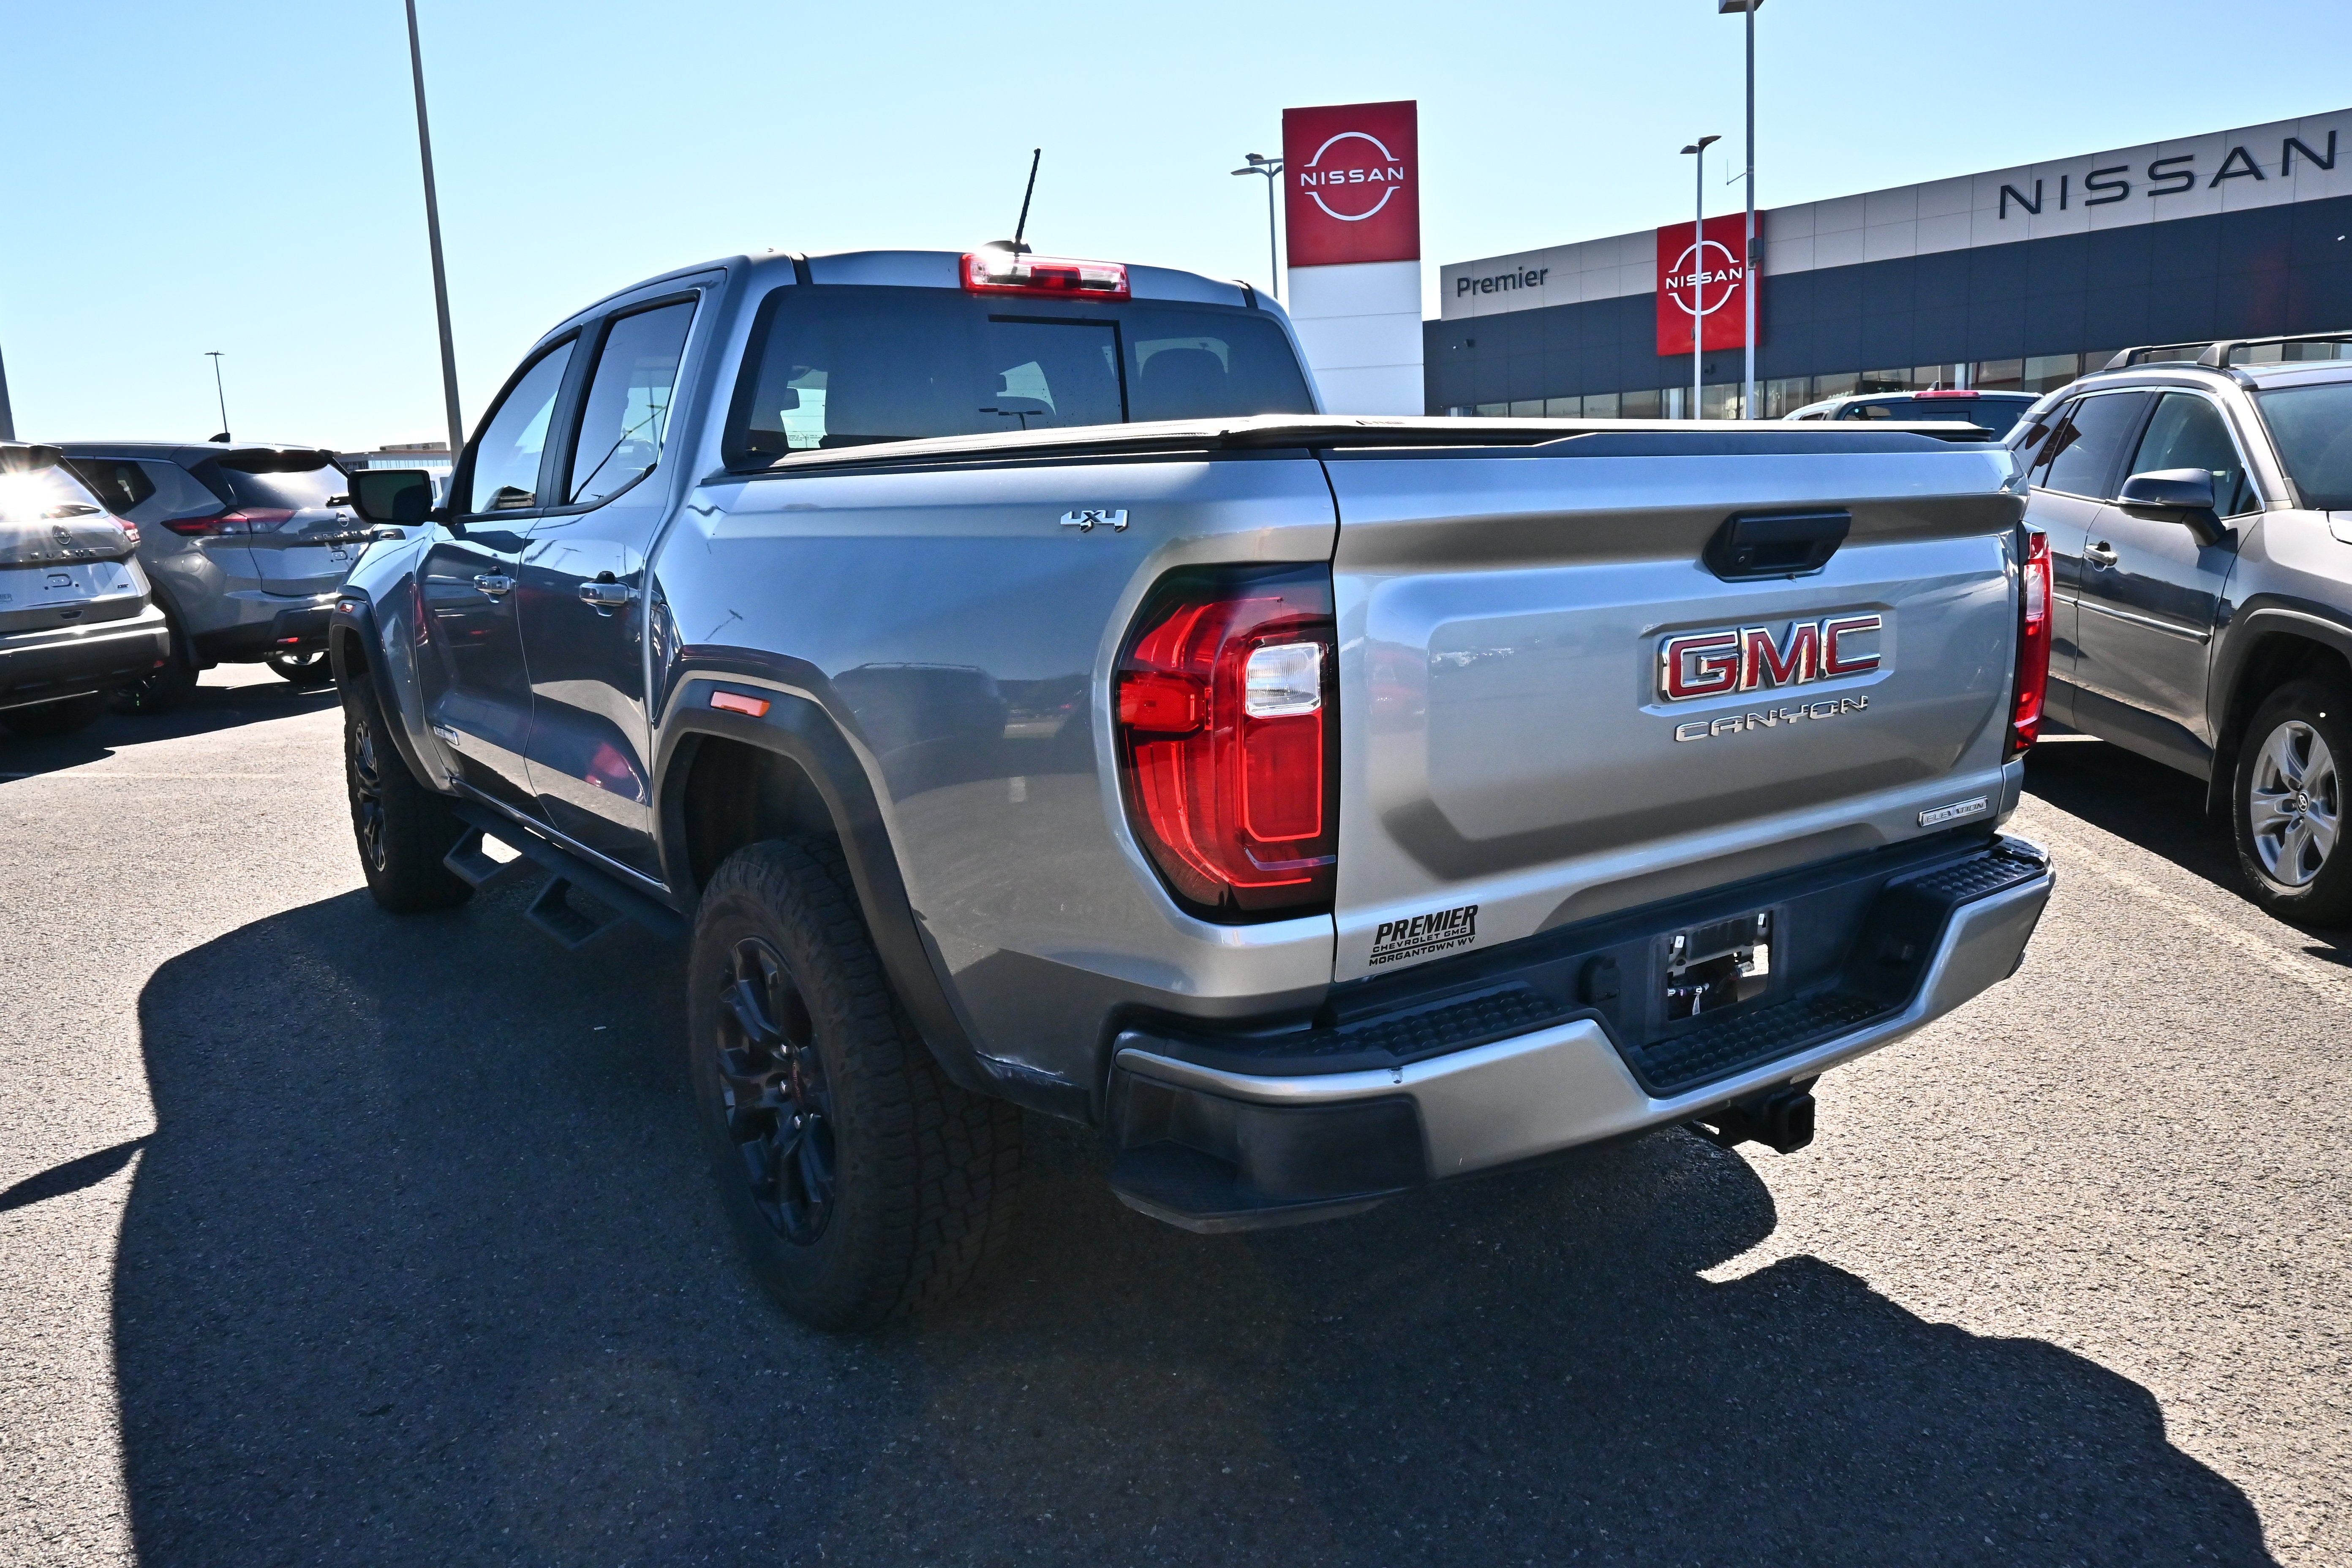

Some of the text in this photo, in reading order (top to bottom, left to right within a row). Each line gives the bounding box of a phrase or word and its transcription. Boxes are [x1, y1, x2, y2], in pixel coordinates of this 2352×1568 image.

[1301, 166, 1404, 186] NISSAN
[1999, 130, 2337, 219] NISSAN
[1457, 267, 1549, 297] Premier
[1666, 267, 1742, 289] NISSAN
[1658, 613, 1882, 702] GMC
[1674, 695, 1869, 742] CANYON
[1925, 802, 1984, 822] ELEVATION
[1374, 904, 1478, 945] PREMIER
[1369, 936, 1475, 966] MORGANTOWN WV
[1373, 927, 1467, 953] CHEVROLET GMC
